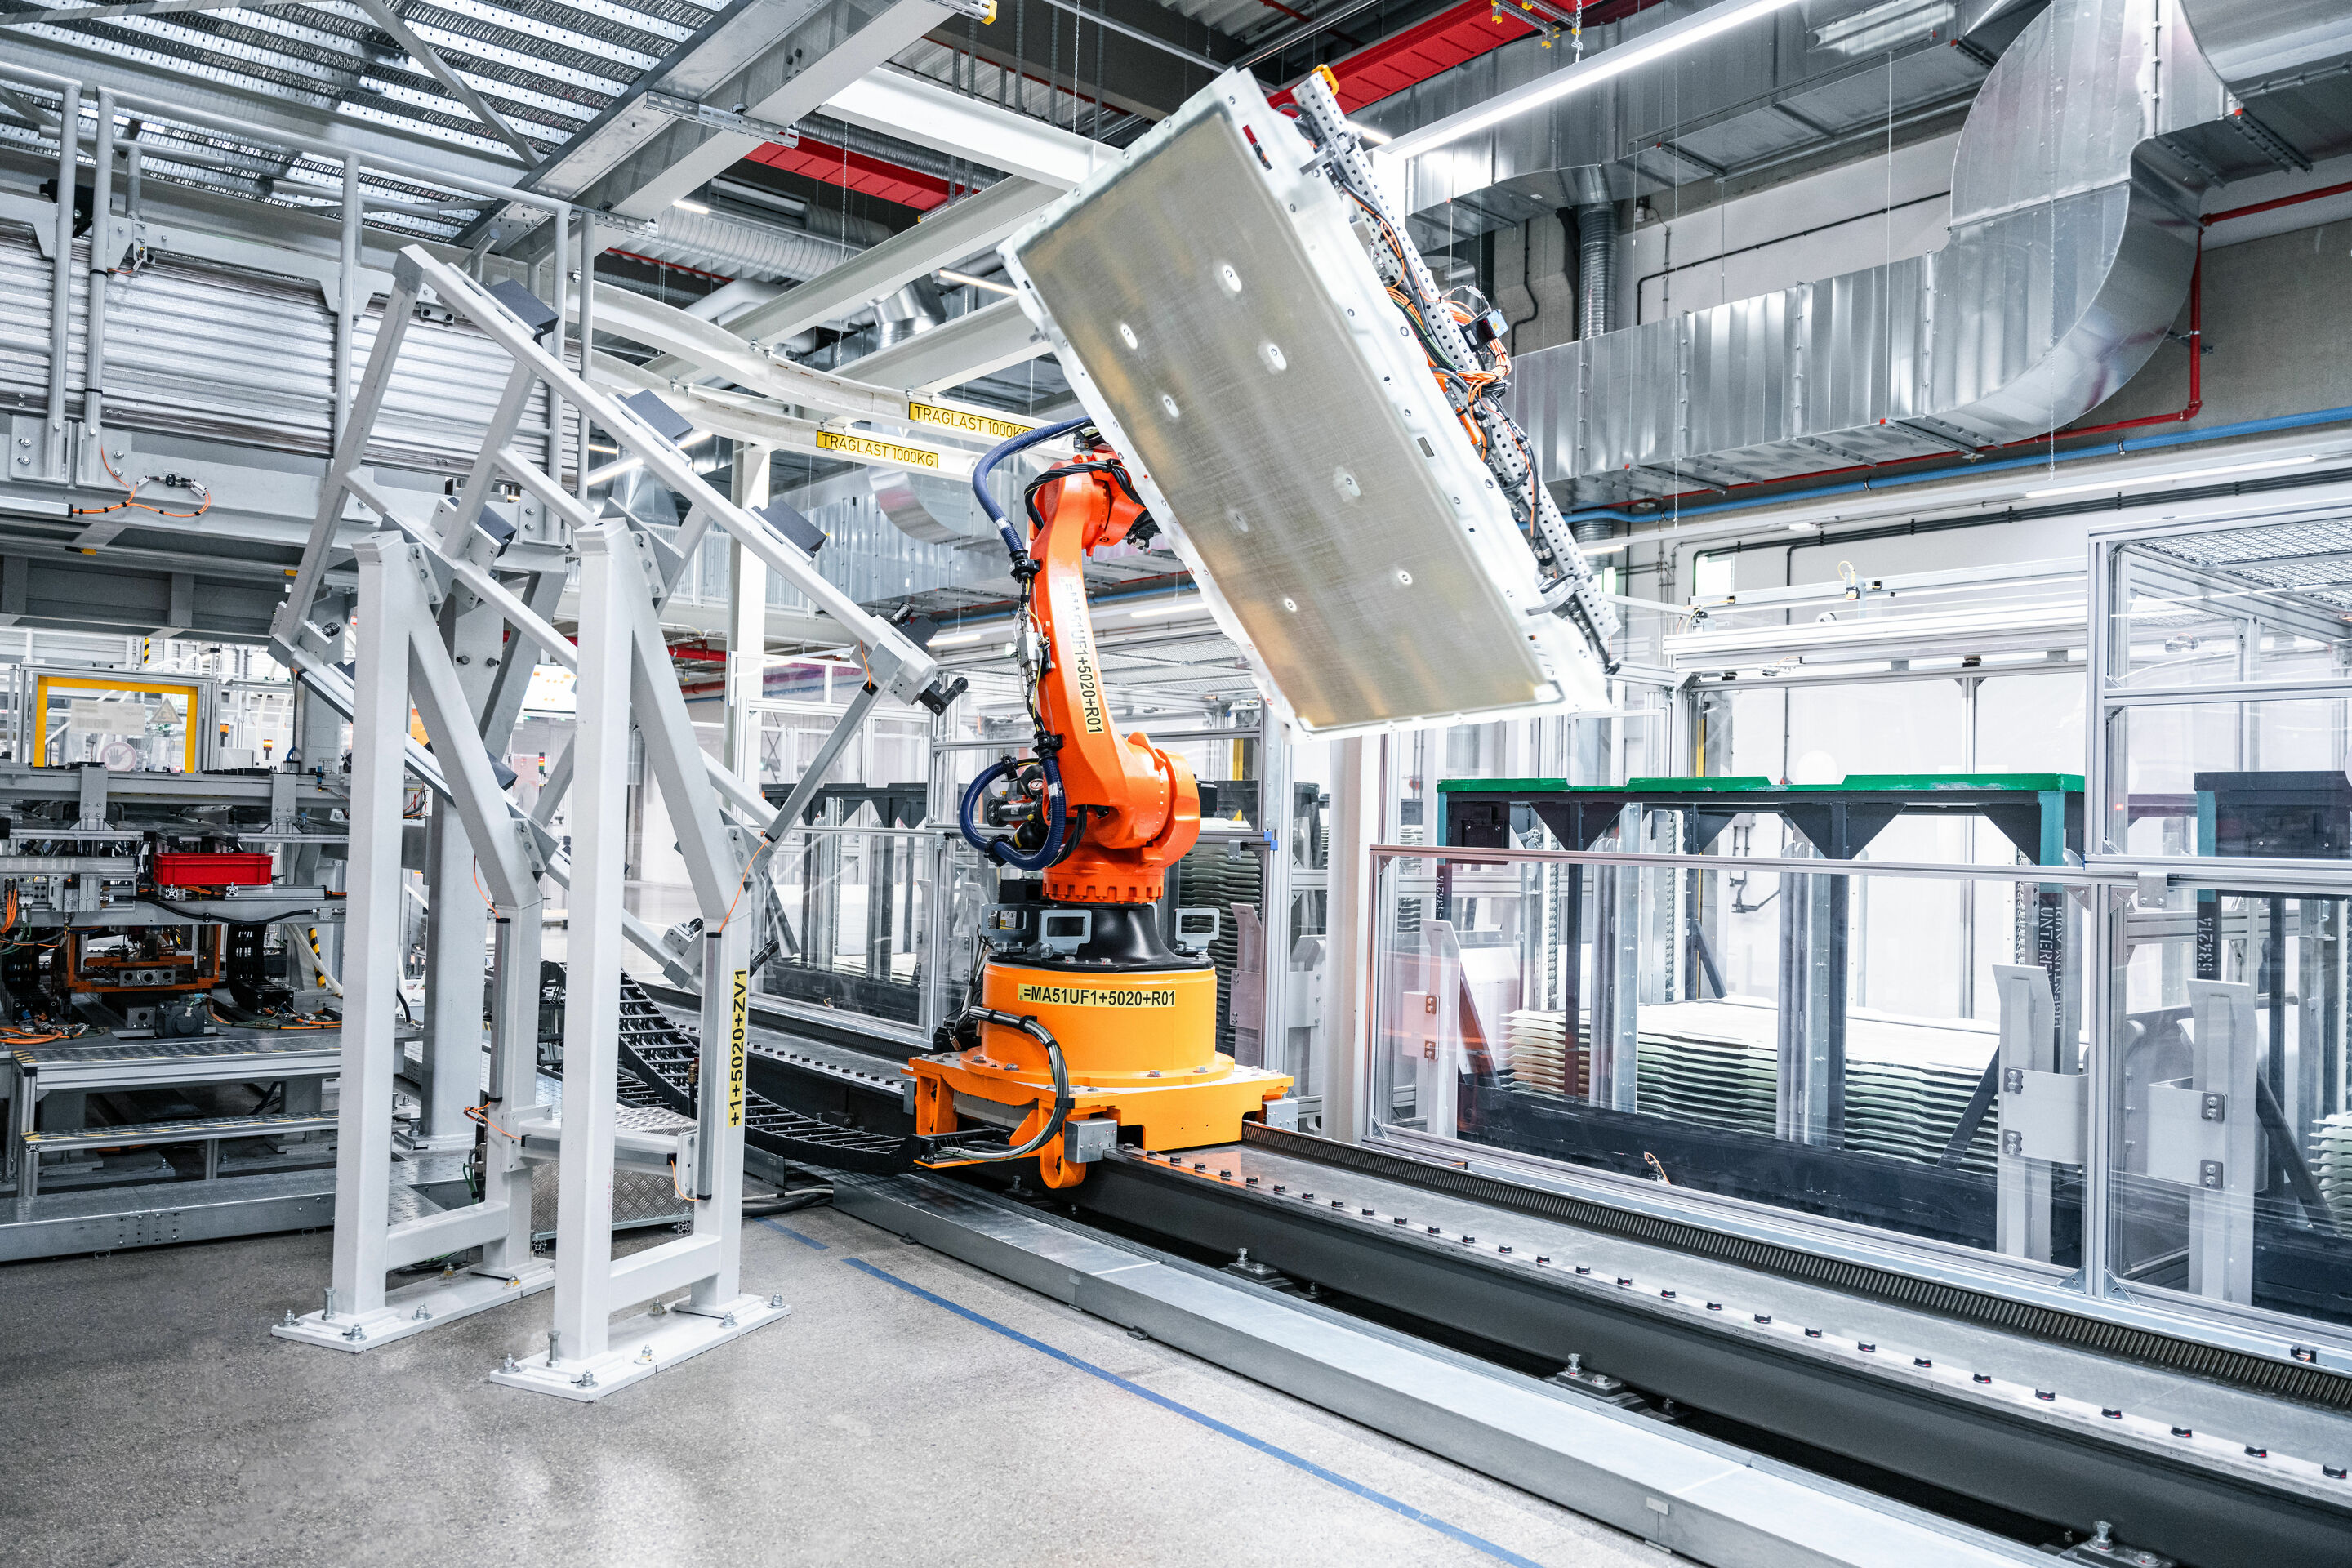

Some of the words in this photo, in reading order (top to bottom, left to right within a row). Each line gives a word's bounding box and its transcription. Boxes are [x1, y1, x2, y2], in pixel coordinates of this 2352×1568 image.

[915, 405, 984, 432] TRAGLAST
[822, 434, 889, 458] TRAGLAST
[893, 448, 933, 466] 1000KG
[2198, 917, 2213, 971] 534214
[1023, 986, 1175, 1006] =MA51UF1+5020+R01
[729, 970, 746, 1125] +1+5020+ZV1
